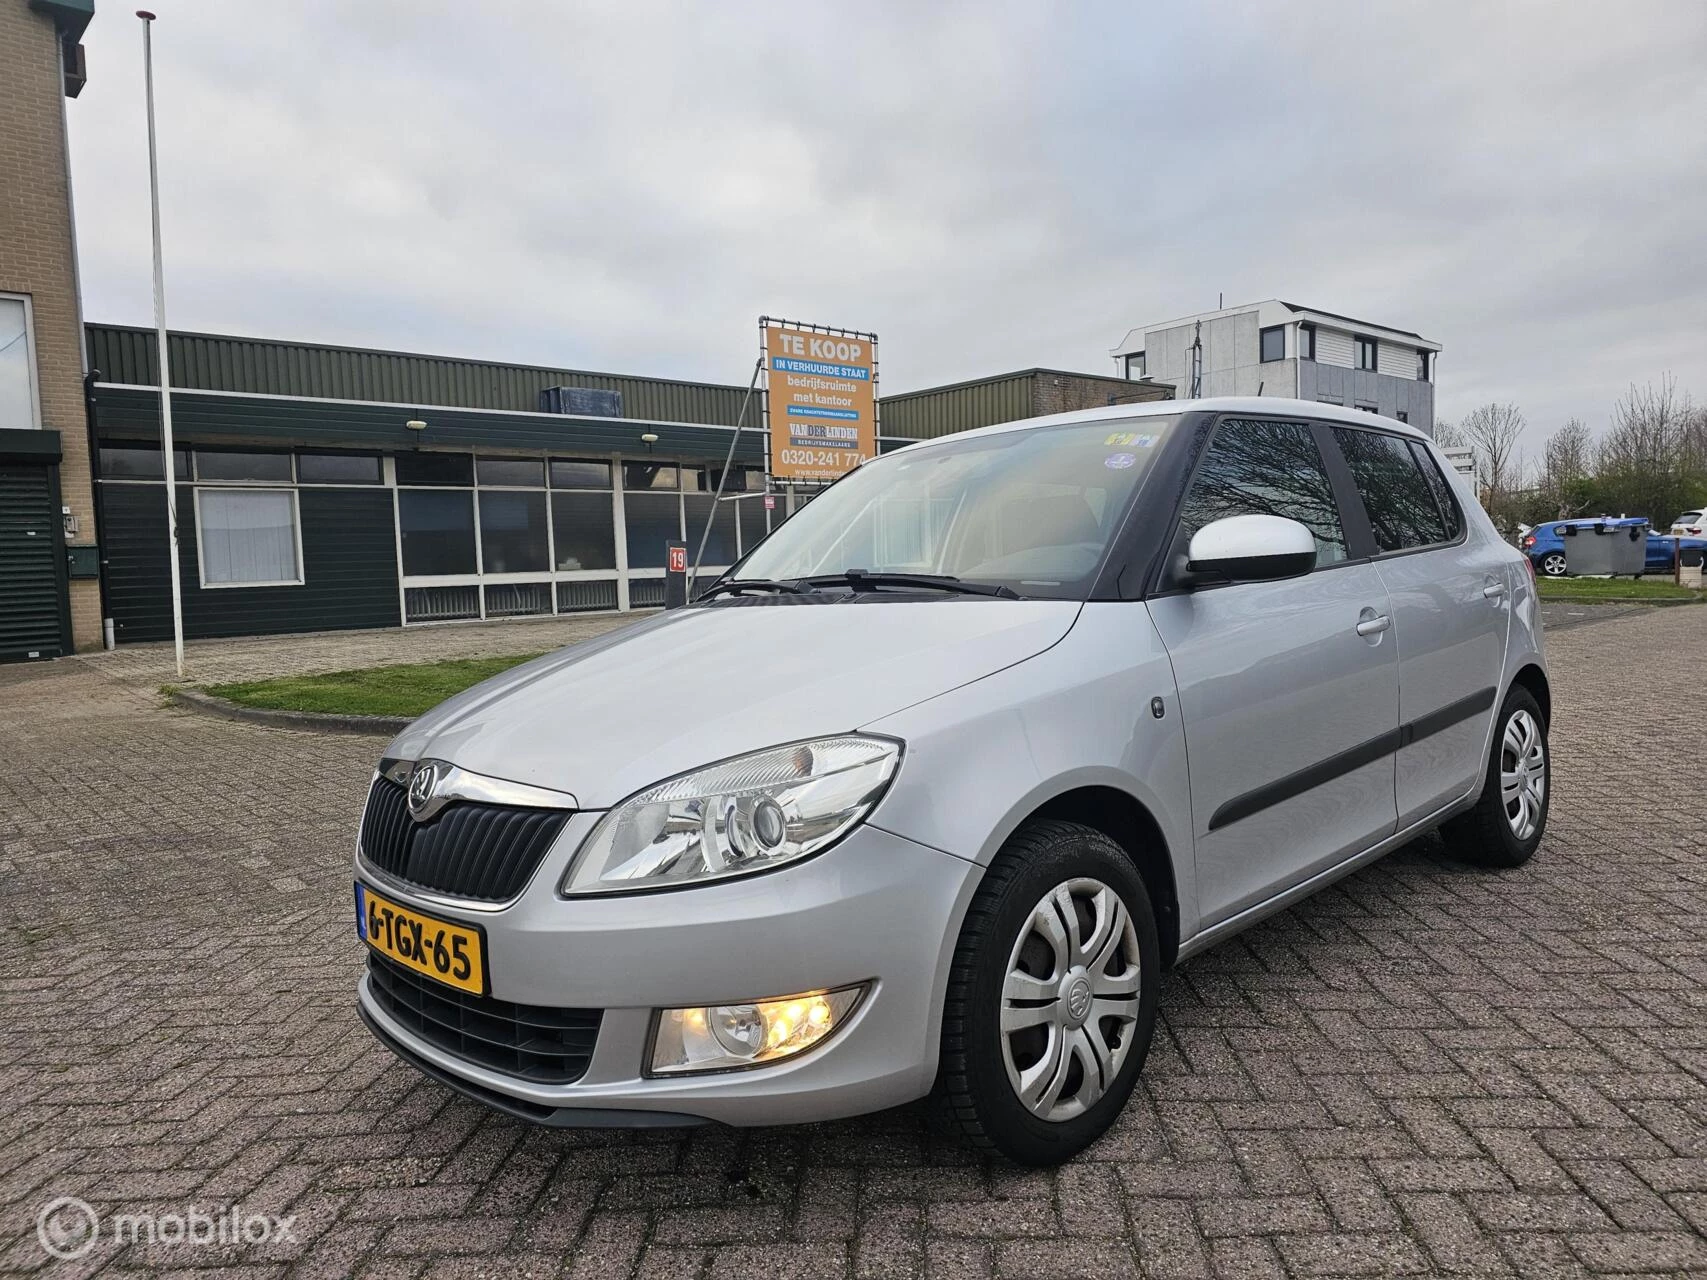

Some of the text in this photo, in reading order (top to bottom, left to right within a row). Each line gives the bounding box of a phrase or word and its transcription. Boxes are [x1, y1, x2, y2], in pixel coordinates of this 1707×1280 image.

[780, 334, 861, 361] TE KOOP
[776, 359, 866, 379] IN VERHUURDE STAAT
[787, 375, 857, 392] bedrijfsruimte
[793, 393, 852, 407] met kantoor
[781, 450, 840, 466] 0320-241
[672, 551, 684, 568] 19
[368, 900, 471, 981] 6-TGX-65
